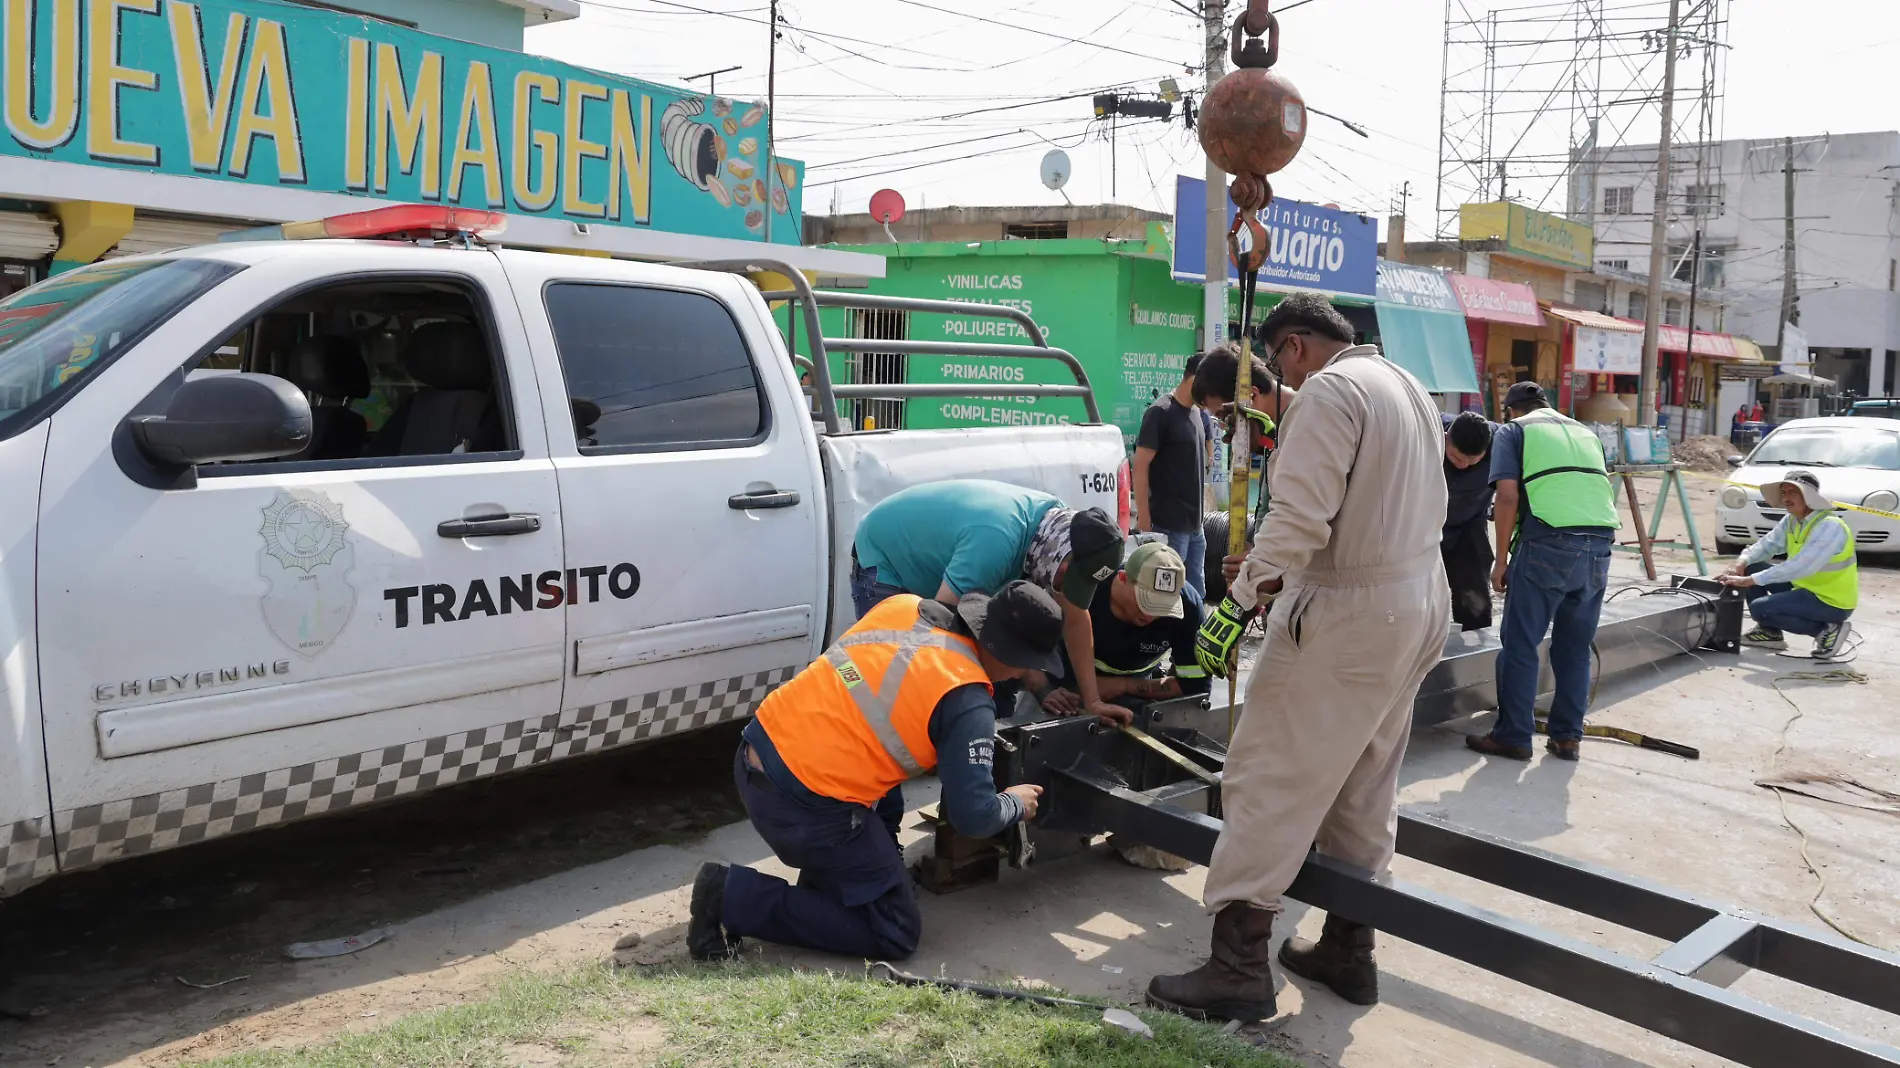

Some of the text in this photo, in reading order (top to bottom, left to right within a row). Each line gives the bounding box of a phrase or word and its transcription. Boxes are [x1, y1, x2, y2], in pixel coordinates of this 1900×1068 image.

[345, 37, 652, 225] IMAGEN
[1269, 222, 1344, 272] uario
[947, 274, 1023, 289] VINILICAS
[1288, 269, 1320, 282] Autorizado
[944, 320, 1050, 339] POLIURETAO
[1169, 312, 1196, 330] COLORES
[1123, 352, 1157, 368] SERVICIO
[943, 363, 1025, 382] PRIMARIOS
[942, 404, 1070, 427] COMPLEMENTOS
[1079, 472, 1115, 494] T-620
[384, 562, 641, 629] TRANSITO
[93, 657, 291, 703] CHEYENNE
